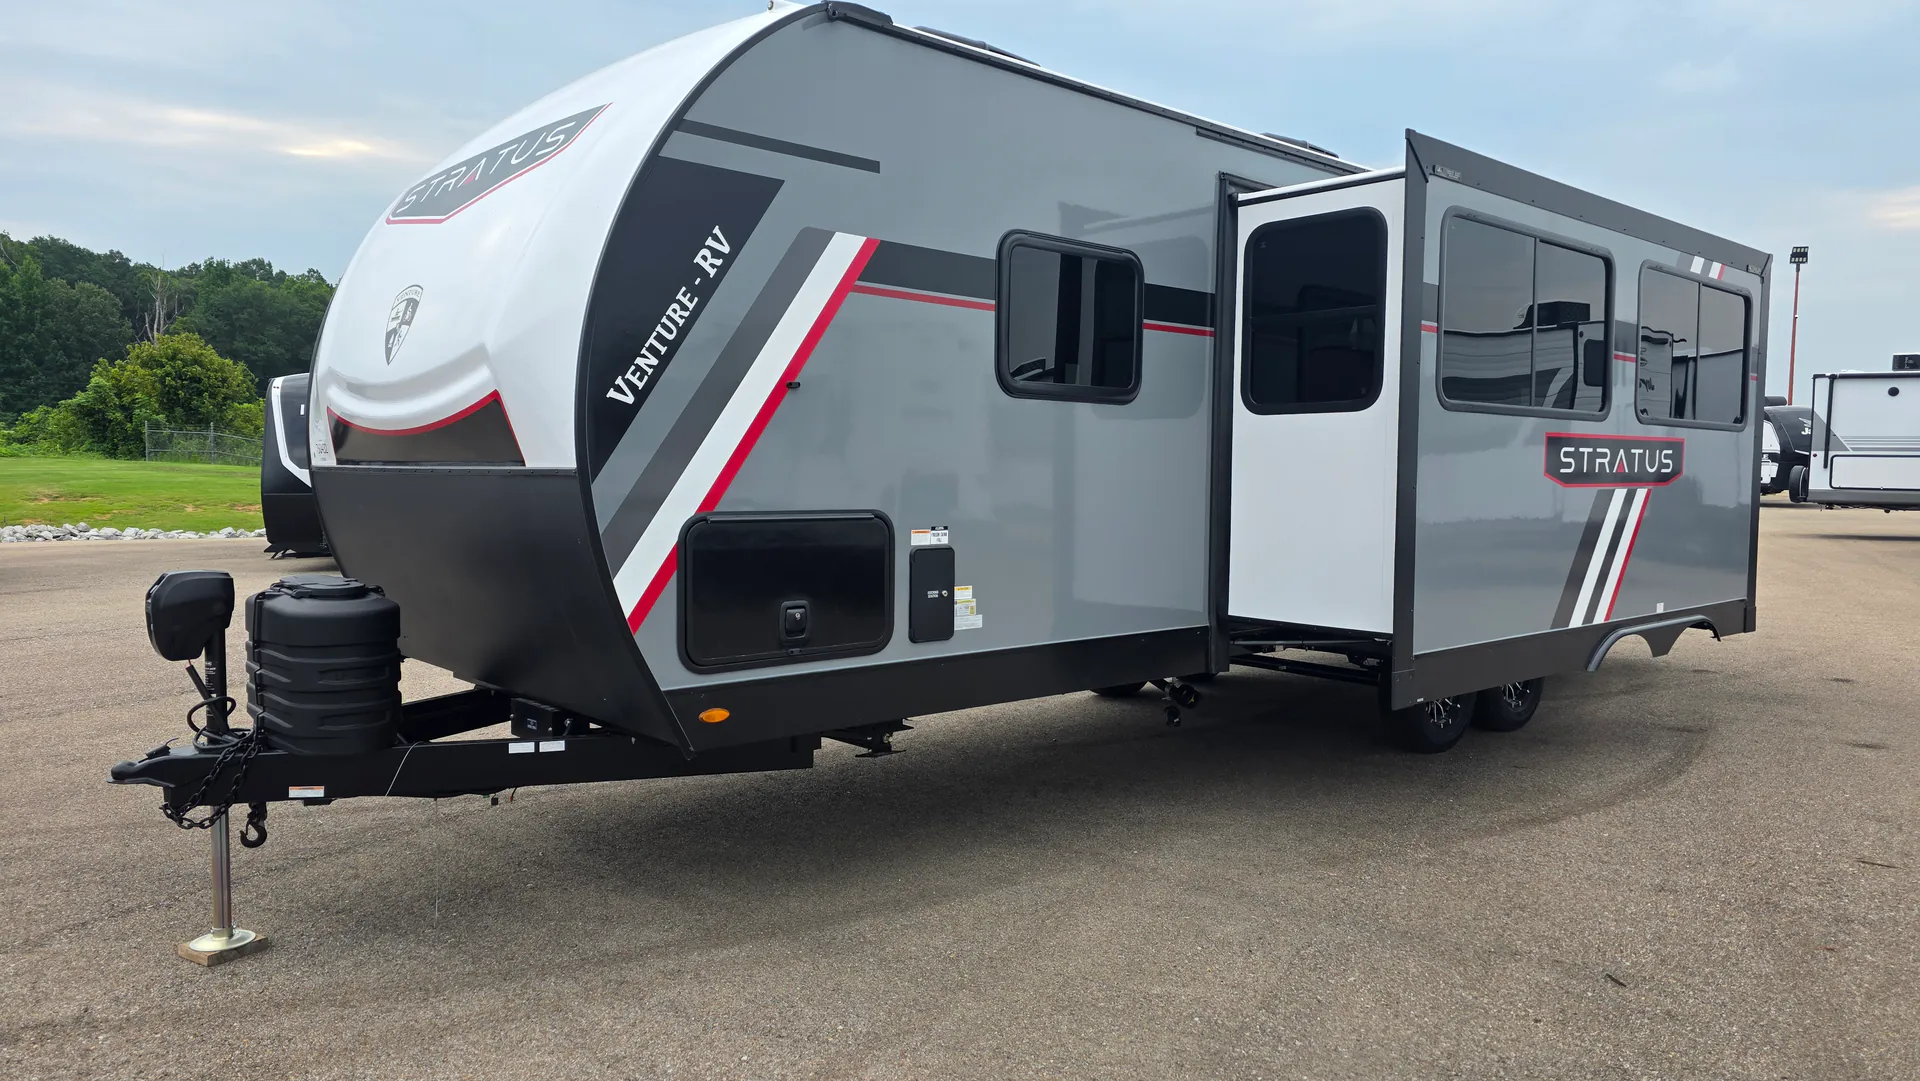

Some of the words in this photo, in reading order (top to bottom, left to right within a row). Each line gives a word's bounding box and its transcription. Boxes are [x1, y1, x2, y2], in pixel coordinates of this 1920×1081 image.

[396, 121, 576, 213] STRATUS
[605, 286, 699, 405] VENTURE
[693, 225, 731, 278] RV
[1559, 446, 1673, 473] STRATUS
